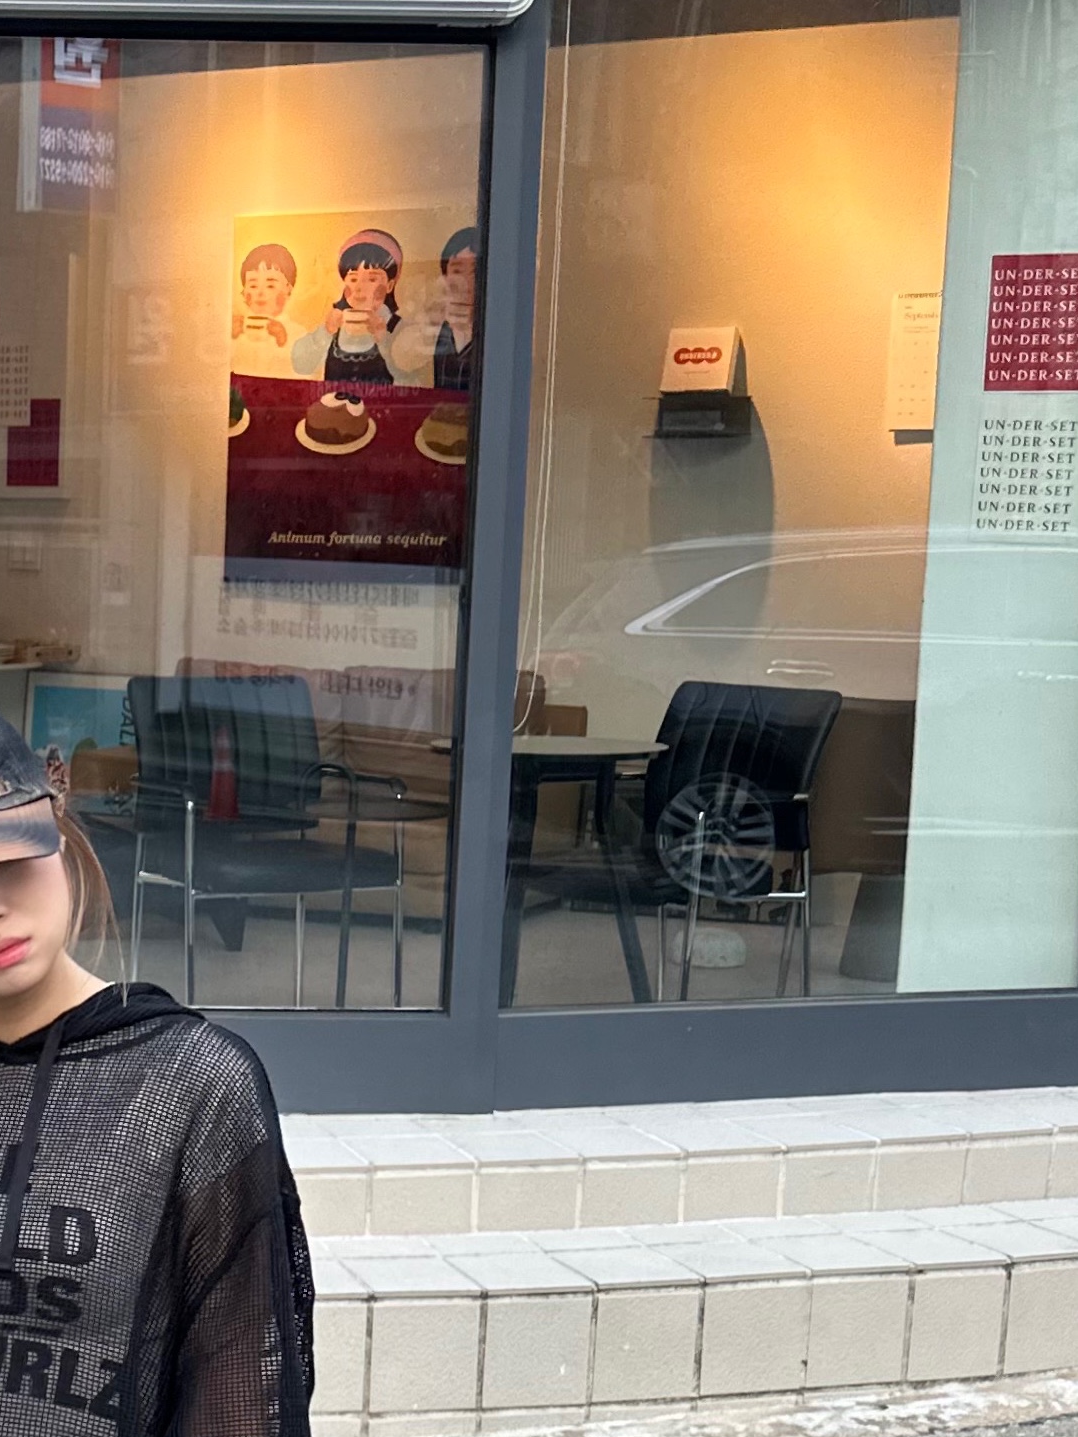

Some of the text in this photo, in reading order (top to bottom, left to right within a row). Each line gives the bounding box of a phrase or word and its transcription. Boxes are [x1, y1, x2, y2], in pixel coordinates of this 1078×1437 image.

[994, 268, 1078, 281] UN·DER·SE
[993, 284, 1078, 297] UN·DER·SE
[992, 300, 1078, 313] UN·DER·SE
[991, 317, 1078, 329] UN·DER·SE
[990, 333, 1078, 345] UN·DER·SE
[989, 351, 1078, 364] UN·DER·SE
[267, 530, 448, 549] Animum fortuna sequitur
